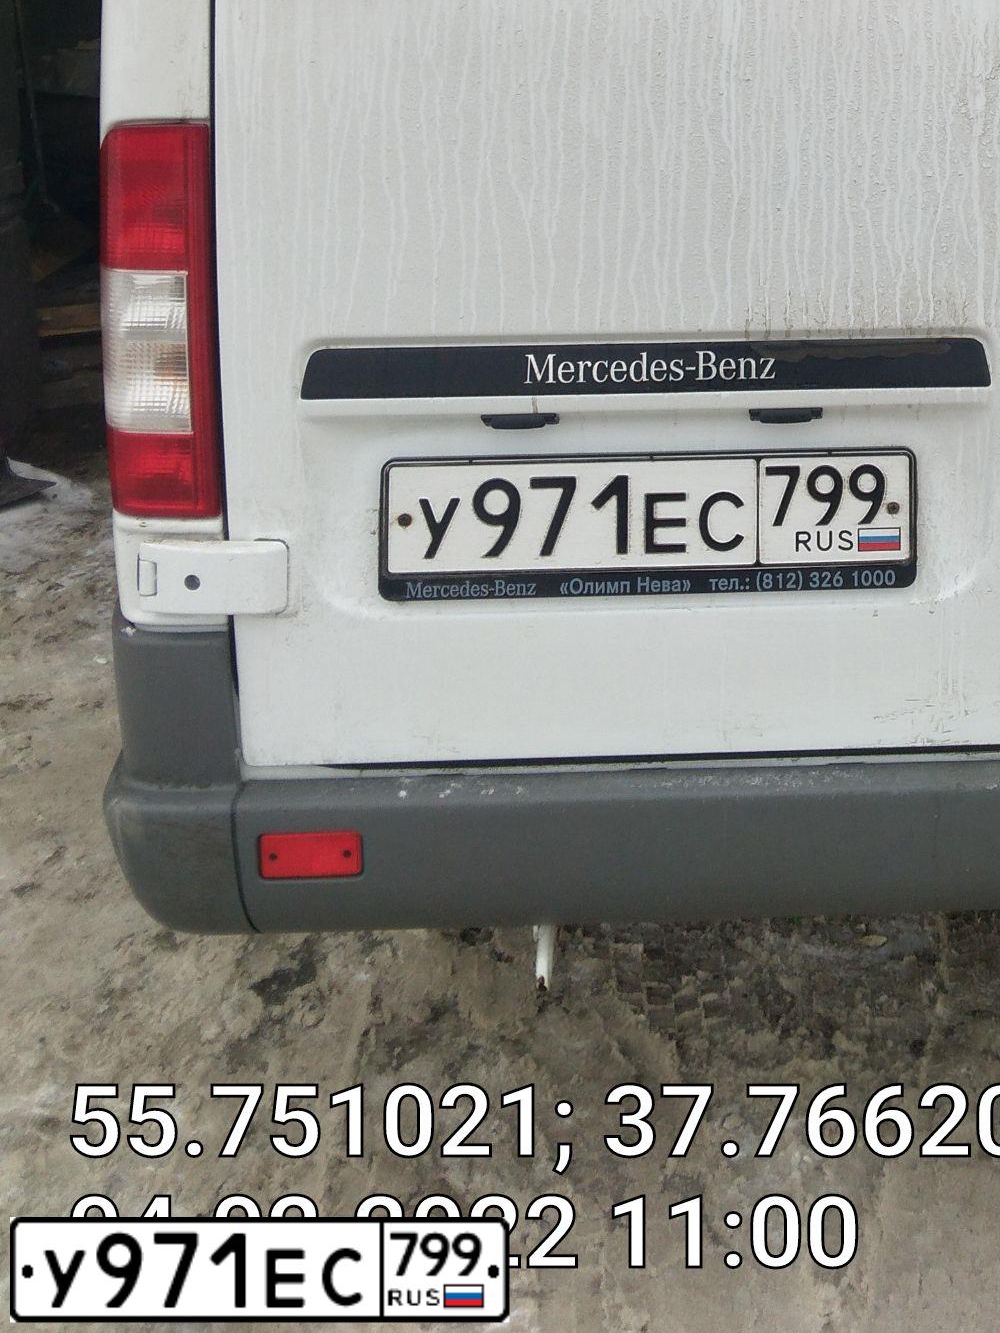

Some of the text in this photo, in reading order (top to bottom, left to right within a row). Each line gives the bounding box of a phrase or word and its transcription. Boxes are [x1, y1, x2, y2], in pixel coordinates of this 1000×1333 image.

[523, 350, 777, 384] Mercedes-Benz
[764, 463, 887, 527] 799
[794, 528, 854, 553] RUS
[404, 569, 897, 600] Mercedes-Benz «Олимп Нева» тел.: (812) 326 1000
